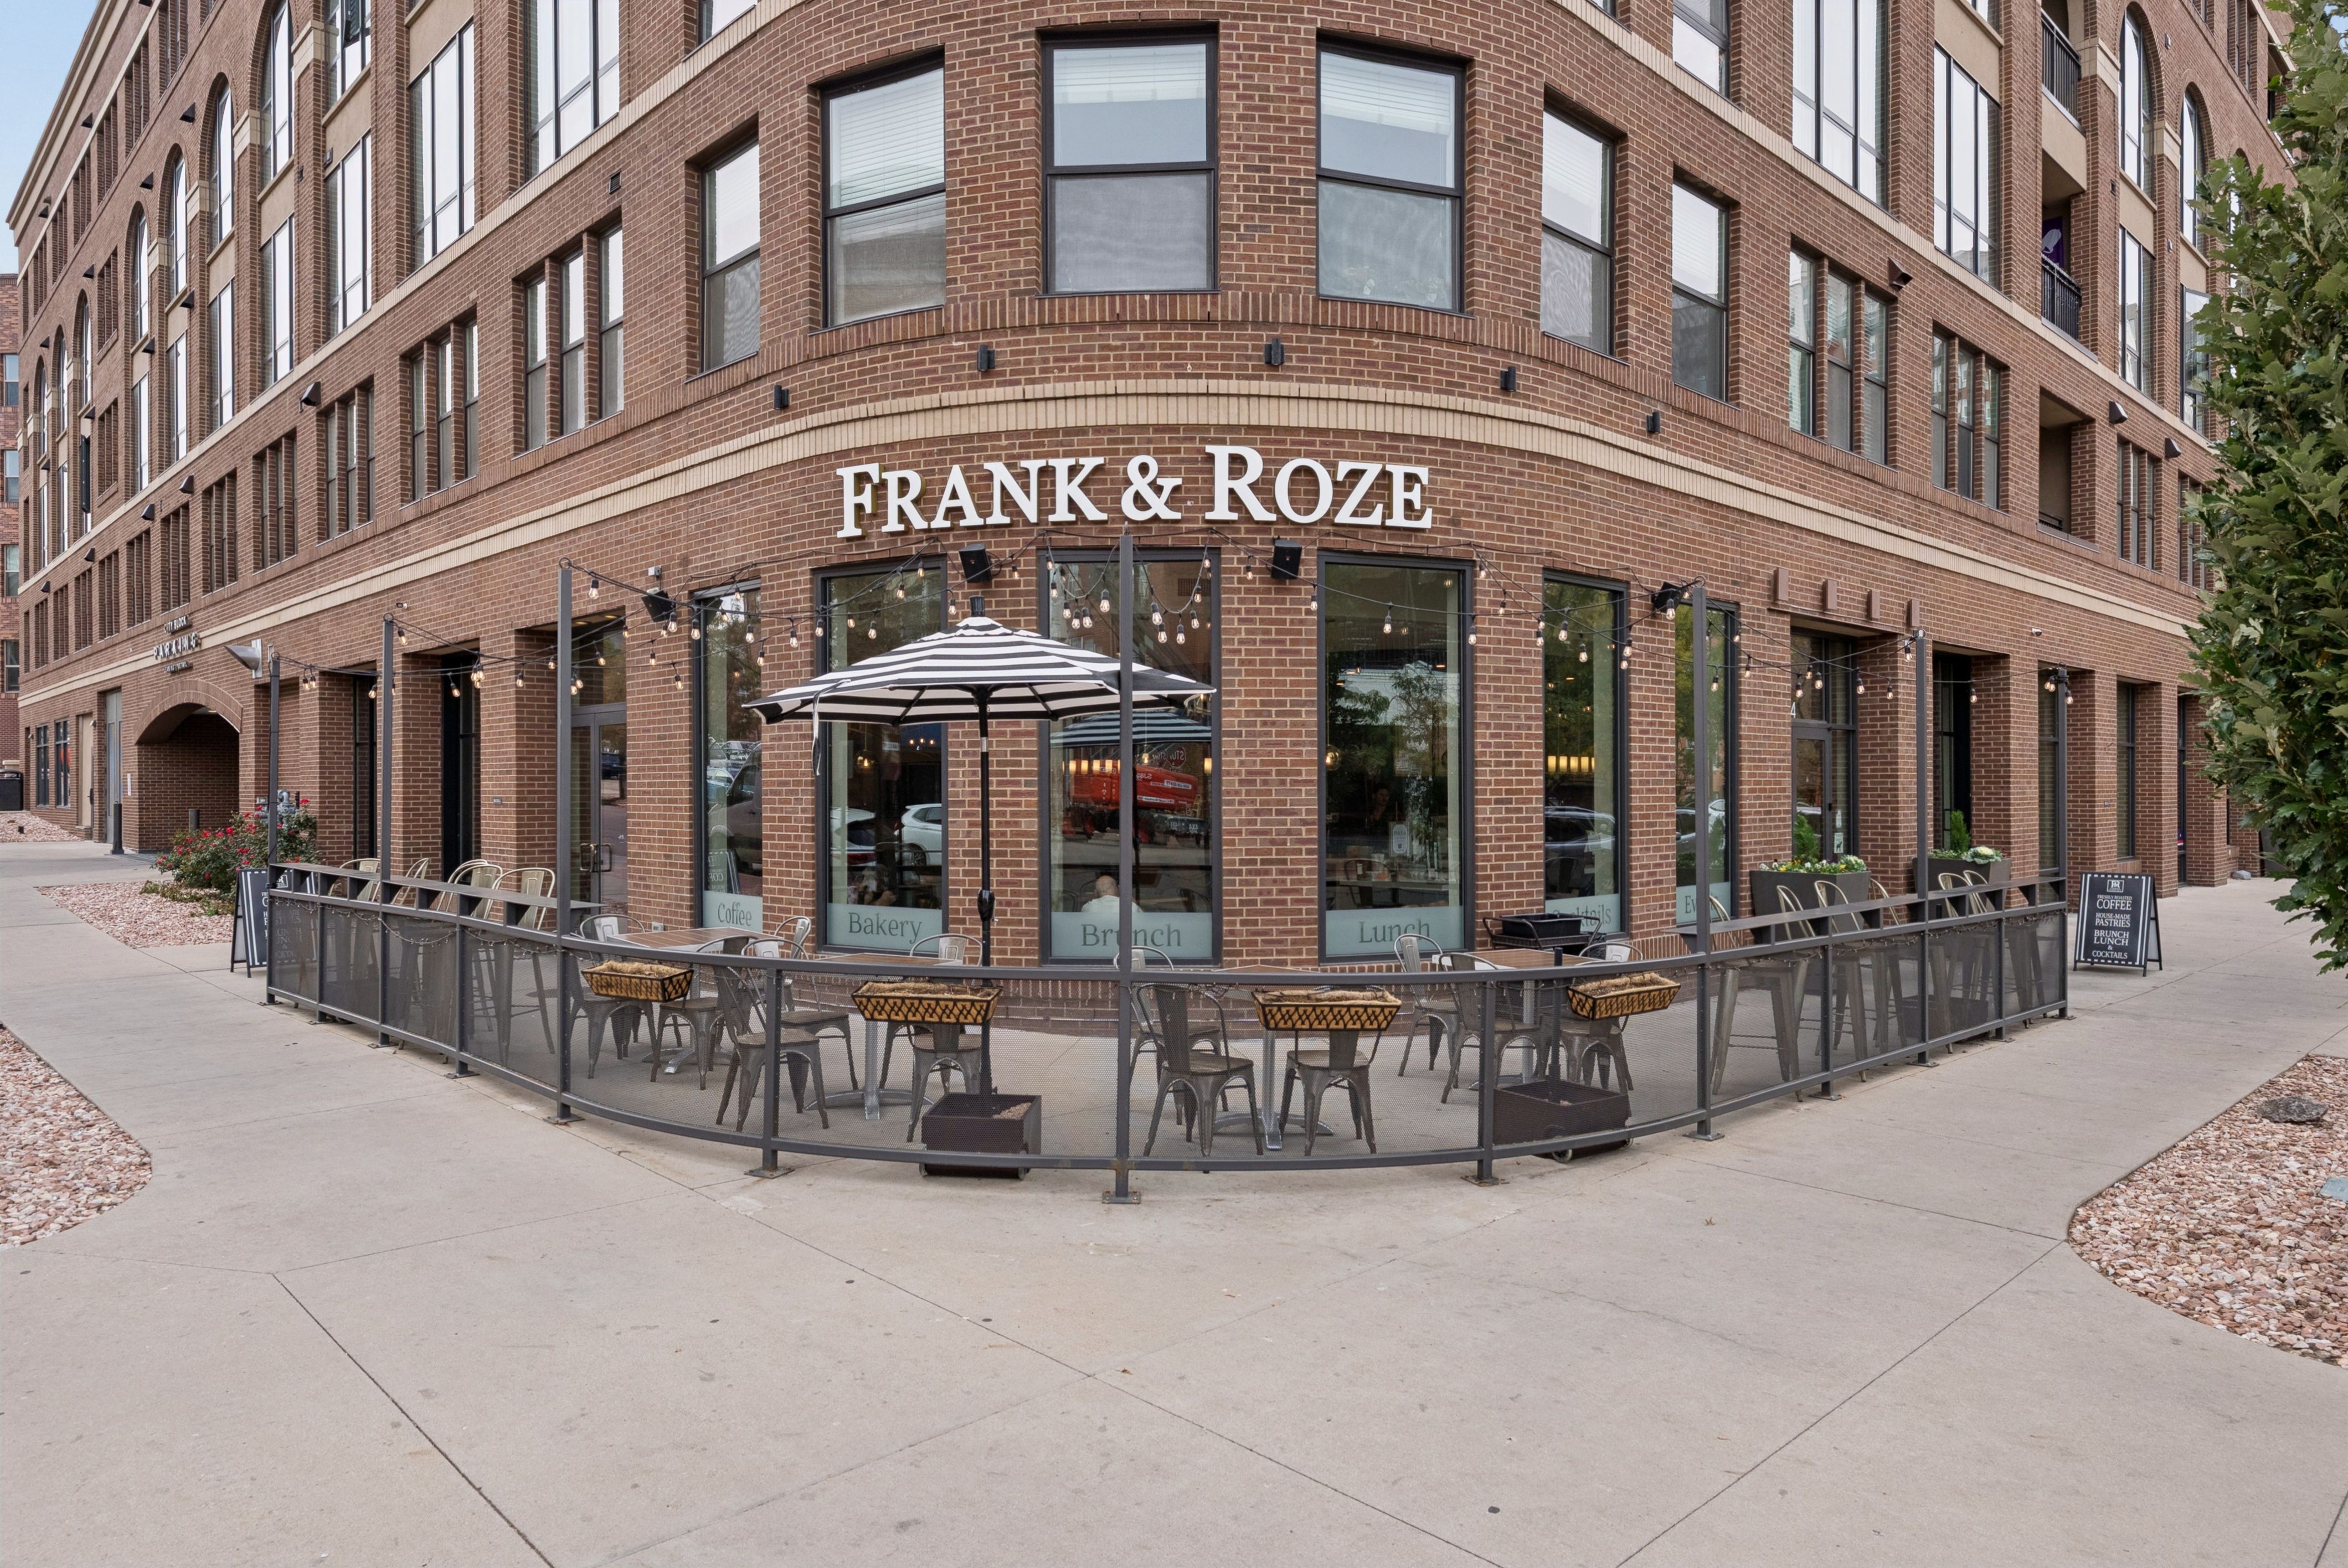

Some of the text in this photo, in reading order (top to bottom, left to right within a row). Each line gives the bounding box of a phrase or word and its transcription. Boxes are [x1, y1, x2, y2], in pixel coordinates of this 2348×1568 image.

[836, 445, 1433, 538] FRANK & ROZE
[174, 615, 189, 630] BLOCK
[153, 632, 198, 660] PARKING
[2097, 899, 2132, 910] COFFEE
[718, 902, 752, 926] Coffee
[1552, 904, 1611, 928] ktails
[848, 912, 923, 945] Bakery
[2095, 918, 2130, 927] PASTRIES
[2094, 929, 2129, 938] BRUNCH
[2094, 937, 2129, 946] LUNCH
[2092, 950, 2128, 959] COCKTAILS
